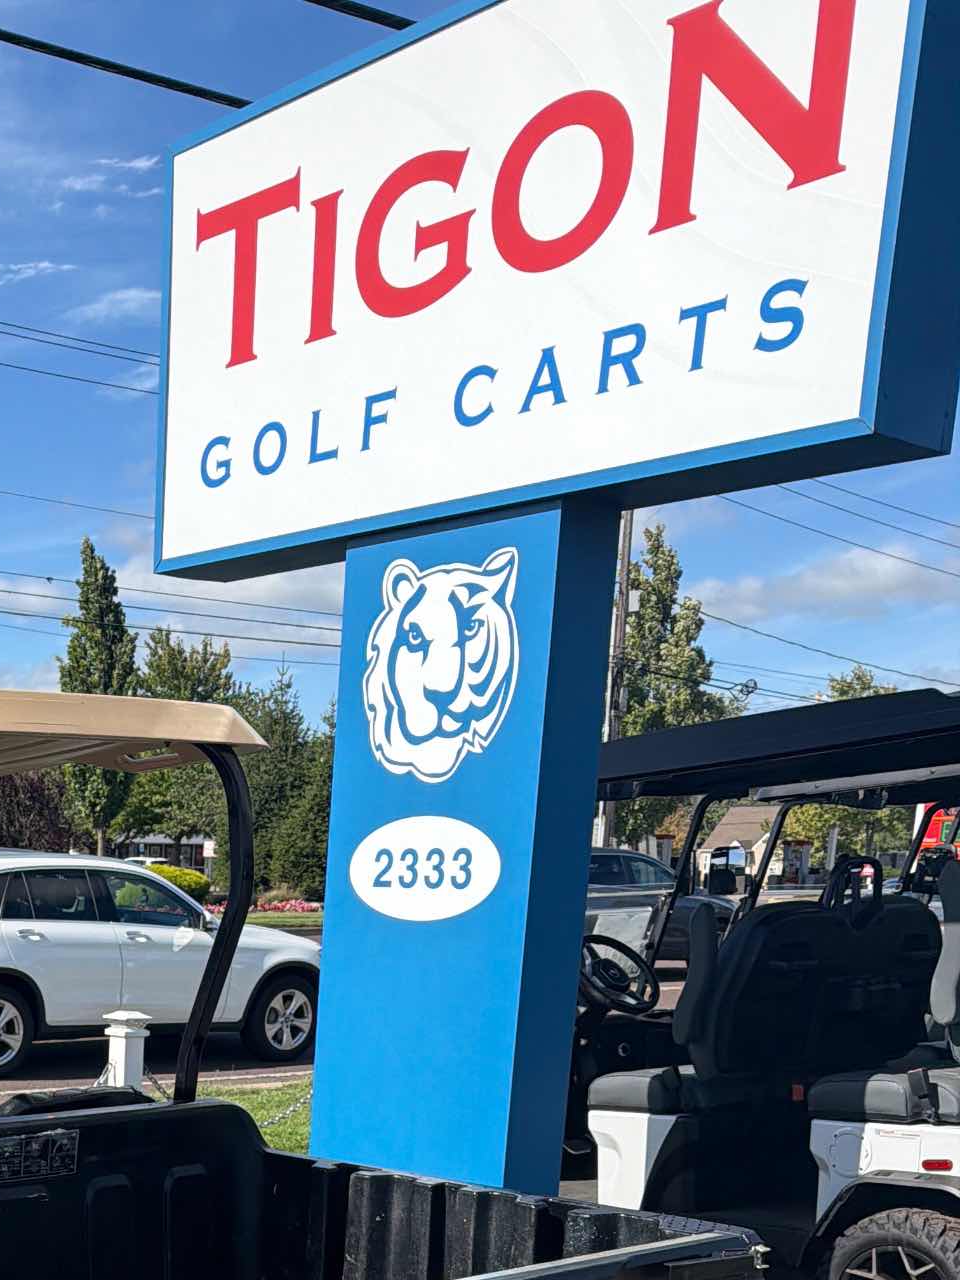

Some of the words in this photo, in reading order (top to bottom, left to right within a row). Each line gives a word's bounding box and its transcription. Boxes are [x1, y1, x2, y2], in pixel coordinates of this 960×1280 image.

[196, 0, 855, 369] TIGON
[200, 388, 397, 489] GOLF
[453, 278, 809, 427] CARTS
[372, 847, 473, 890] 2333
